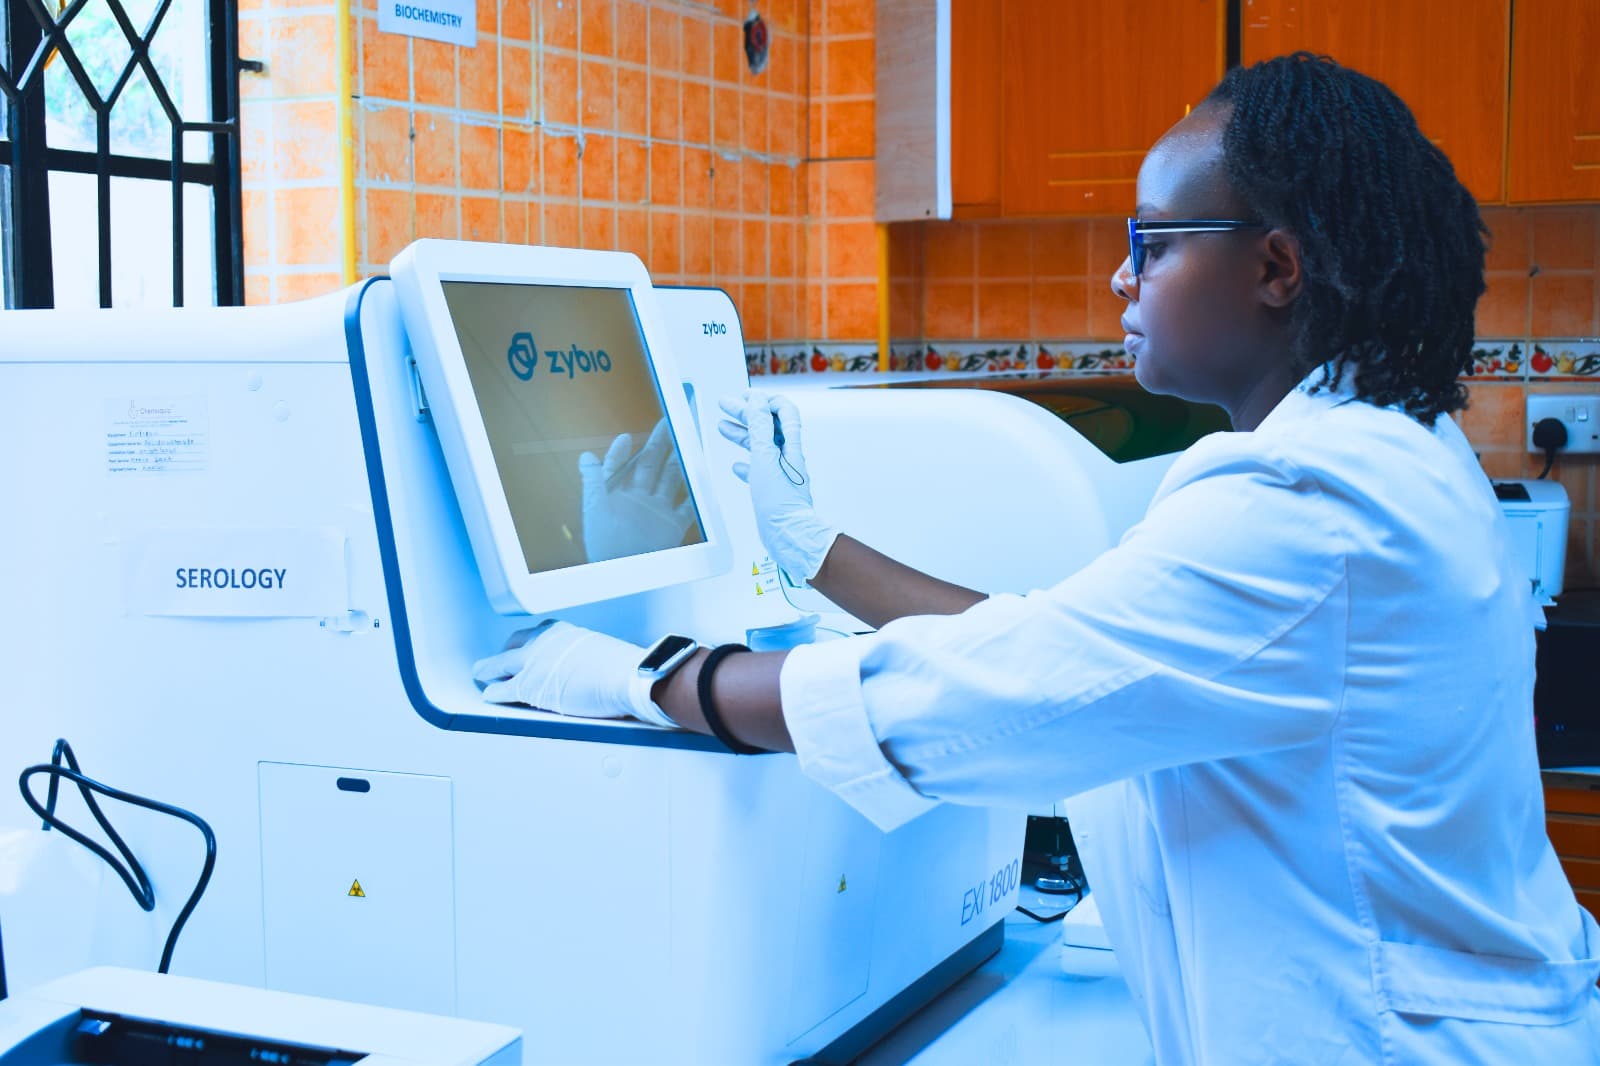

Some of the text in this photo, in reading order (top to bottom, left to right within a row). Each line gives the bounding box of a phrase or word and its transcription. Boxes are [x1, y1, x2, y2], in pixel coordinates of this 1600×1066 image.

[395, 3, 463, 28] BIOCHEMISTRY
[702, 320, 727, 338] zybio
[544, 343, 612, 379] zybio
[176, 568, 287, 589] SEROLOGY
[961, 858, 1019, 927] EXI 1800
